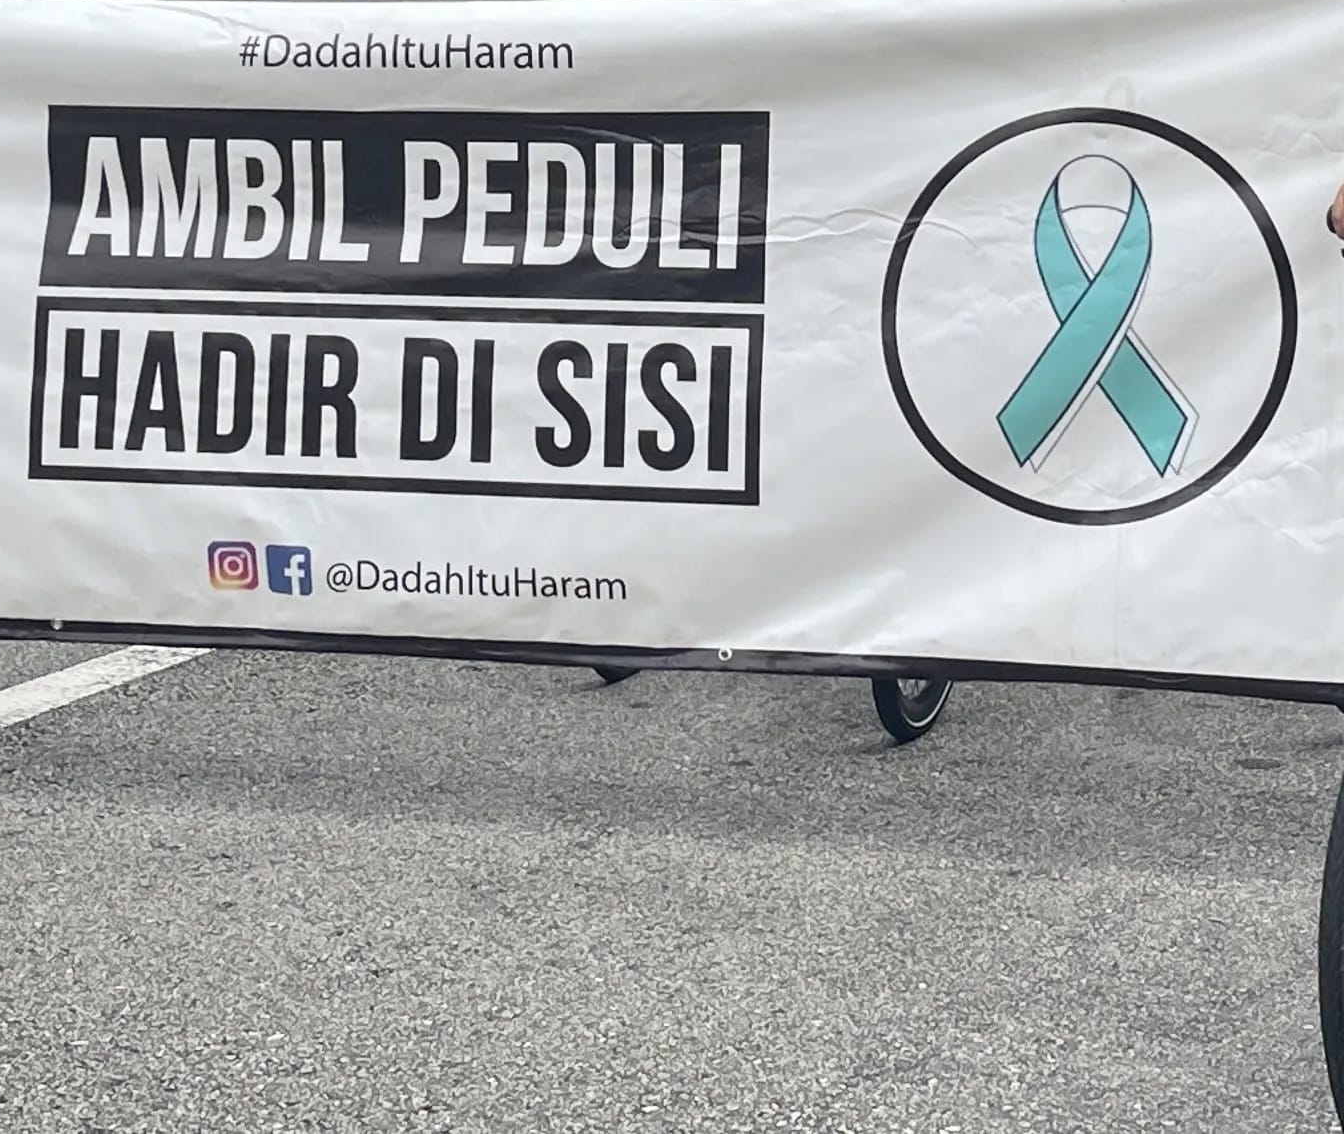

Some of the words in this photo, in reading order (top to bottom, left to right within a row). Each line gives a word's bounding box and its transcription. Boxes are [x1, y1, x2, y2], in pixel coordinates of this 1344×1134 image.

[239, 33, 574, 70] #DadahItuHaram
[67, 135, 370, 262] AMBIL
[399, 140, 743, 270] PEDULI
[59, 328, 359, 460] HADIR
[399, 337, 496, 464] DI
[534, 340, 733, 472] SISI
[325, 560, 627, 601] @DadahItuHaram
